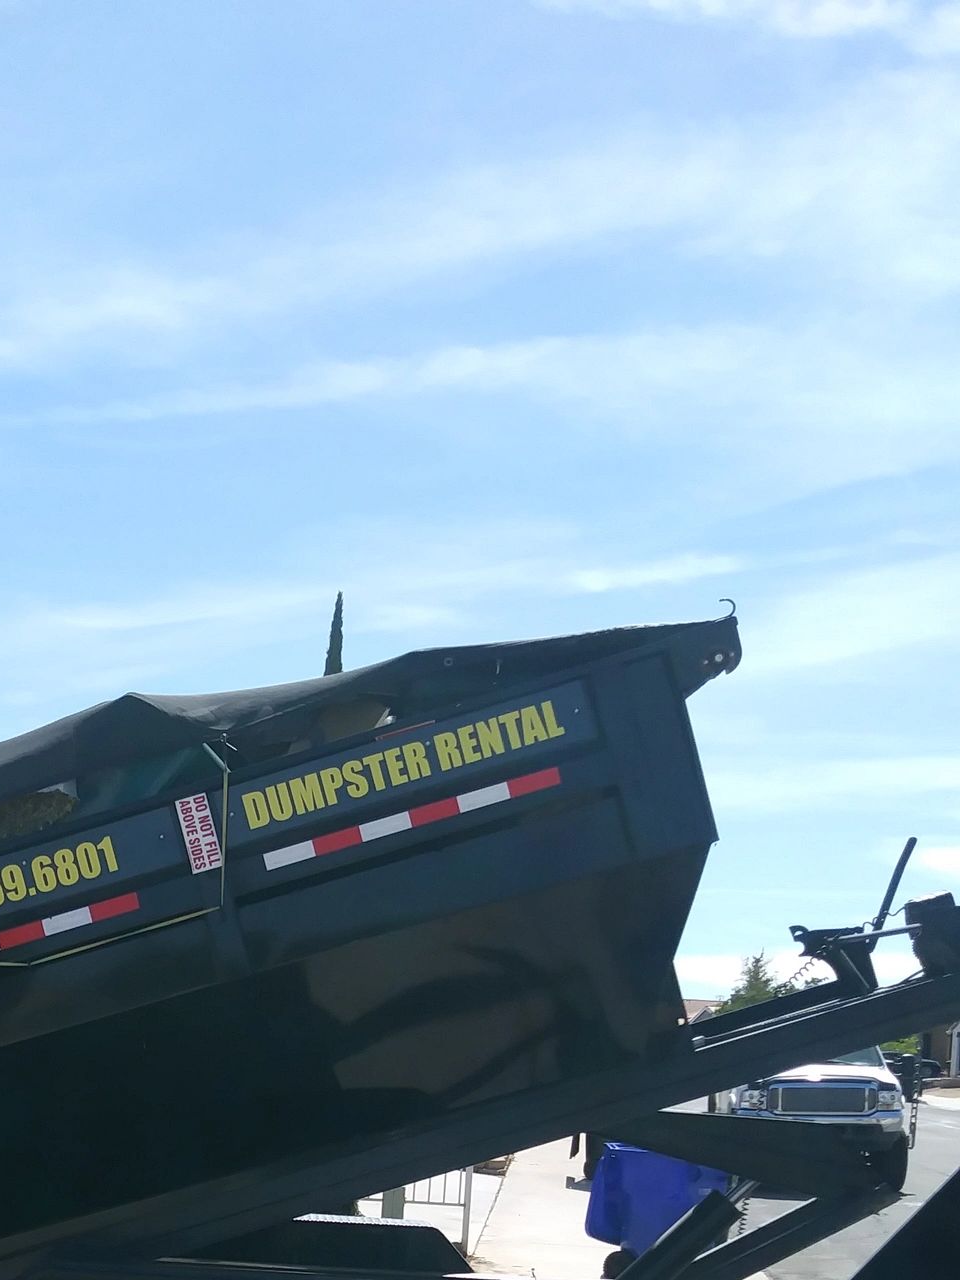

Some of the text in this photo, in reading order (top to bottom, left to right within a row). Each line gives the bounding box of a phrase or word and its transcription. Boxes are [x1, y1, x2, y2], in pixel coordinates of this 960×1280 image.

[241, 700, 565, 830] DUMPSTER RENTAL
[178, 800, 207, 871] ABOVE SIDES
[192, 794, 221, 867] DO NOT FILL
